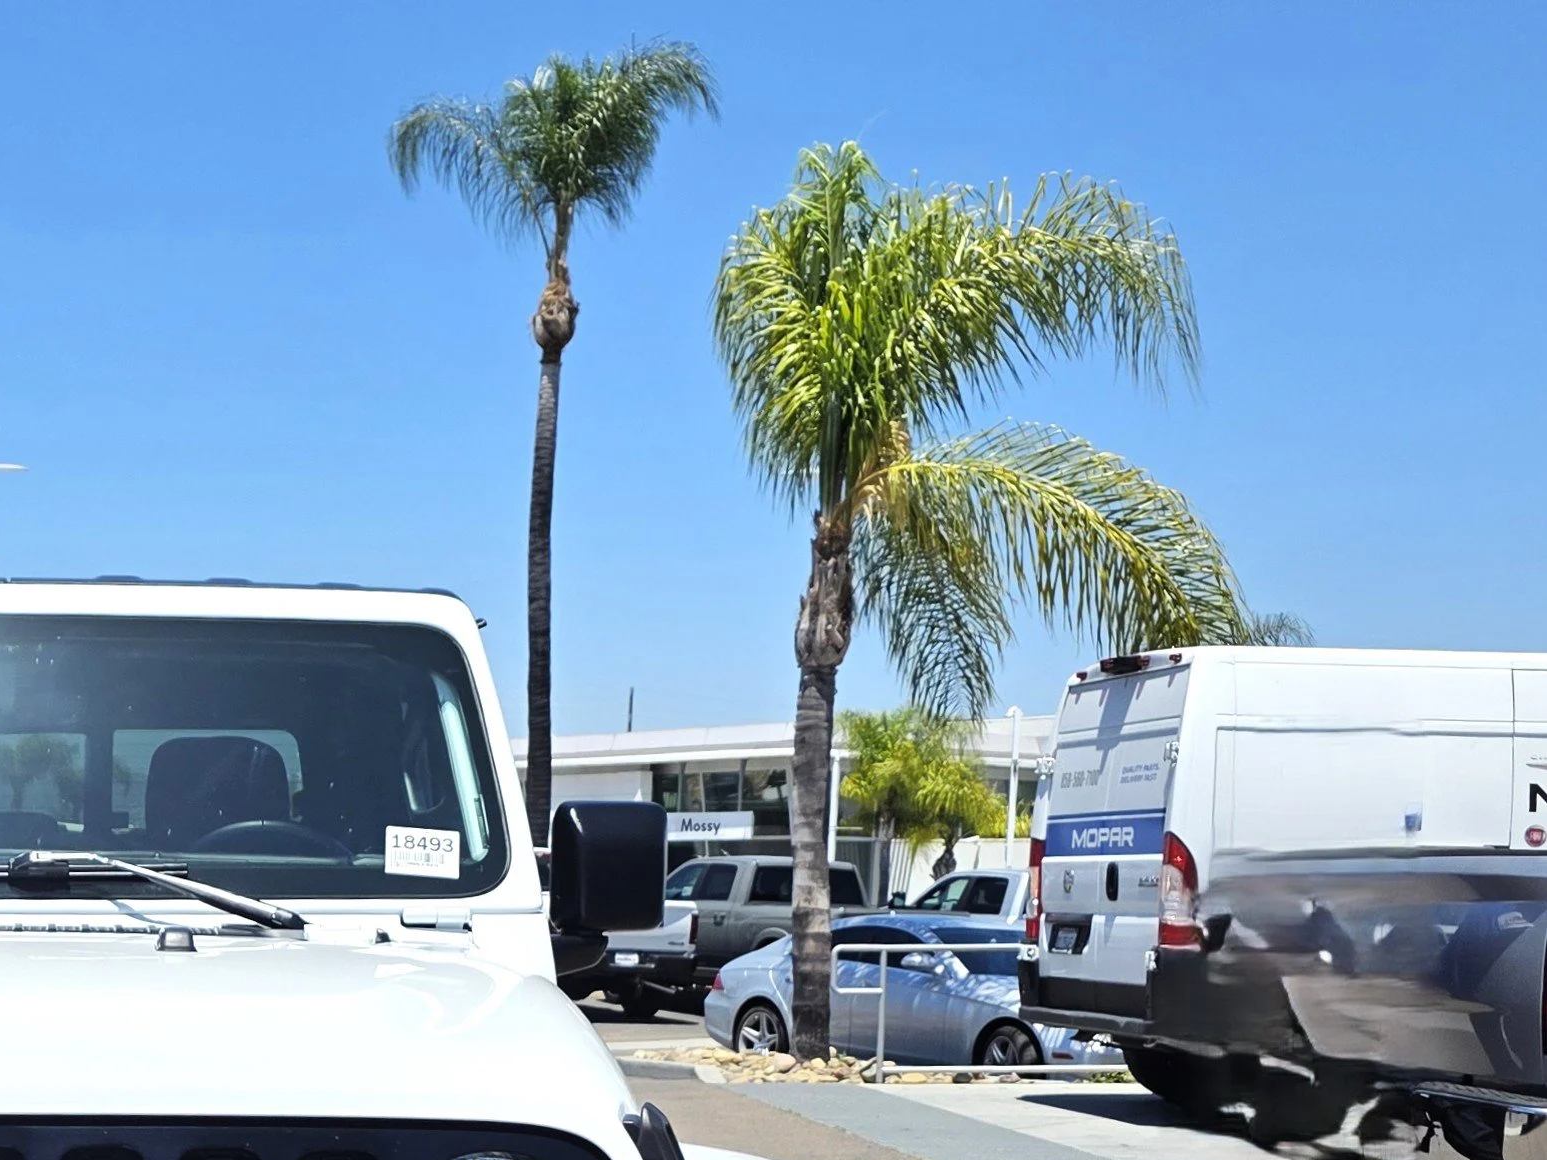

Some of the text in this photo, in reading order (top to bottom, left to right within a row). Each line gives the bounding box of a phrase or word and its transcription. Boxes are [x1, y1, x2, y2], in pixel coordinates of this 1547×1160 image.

[680, 818, 721, 836] Mossy
[391, 833, 454, 853] 18493
[1071, 826, 1135, 849] MOPAR
